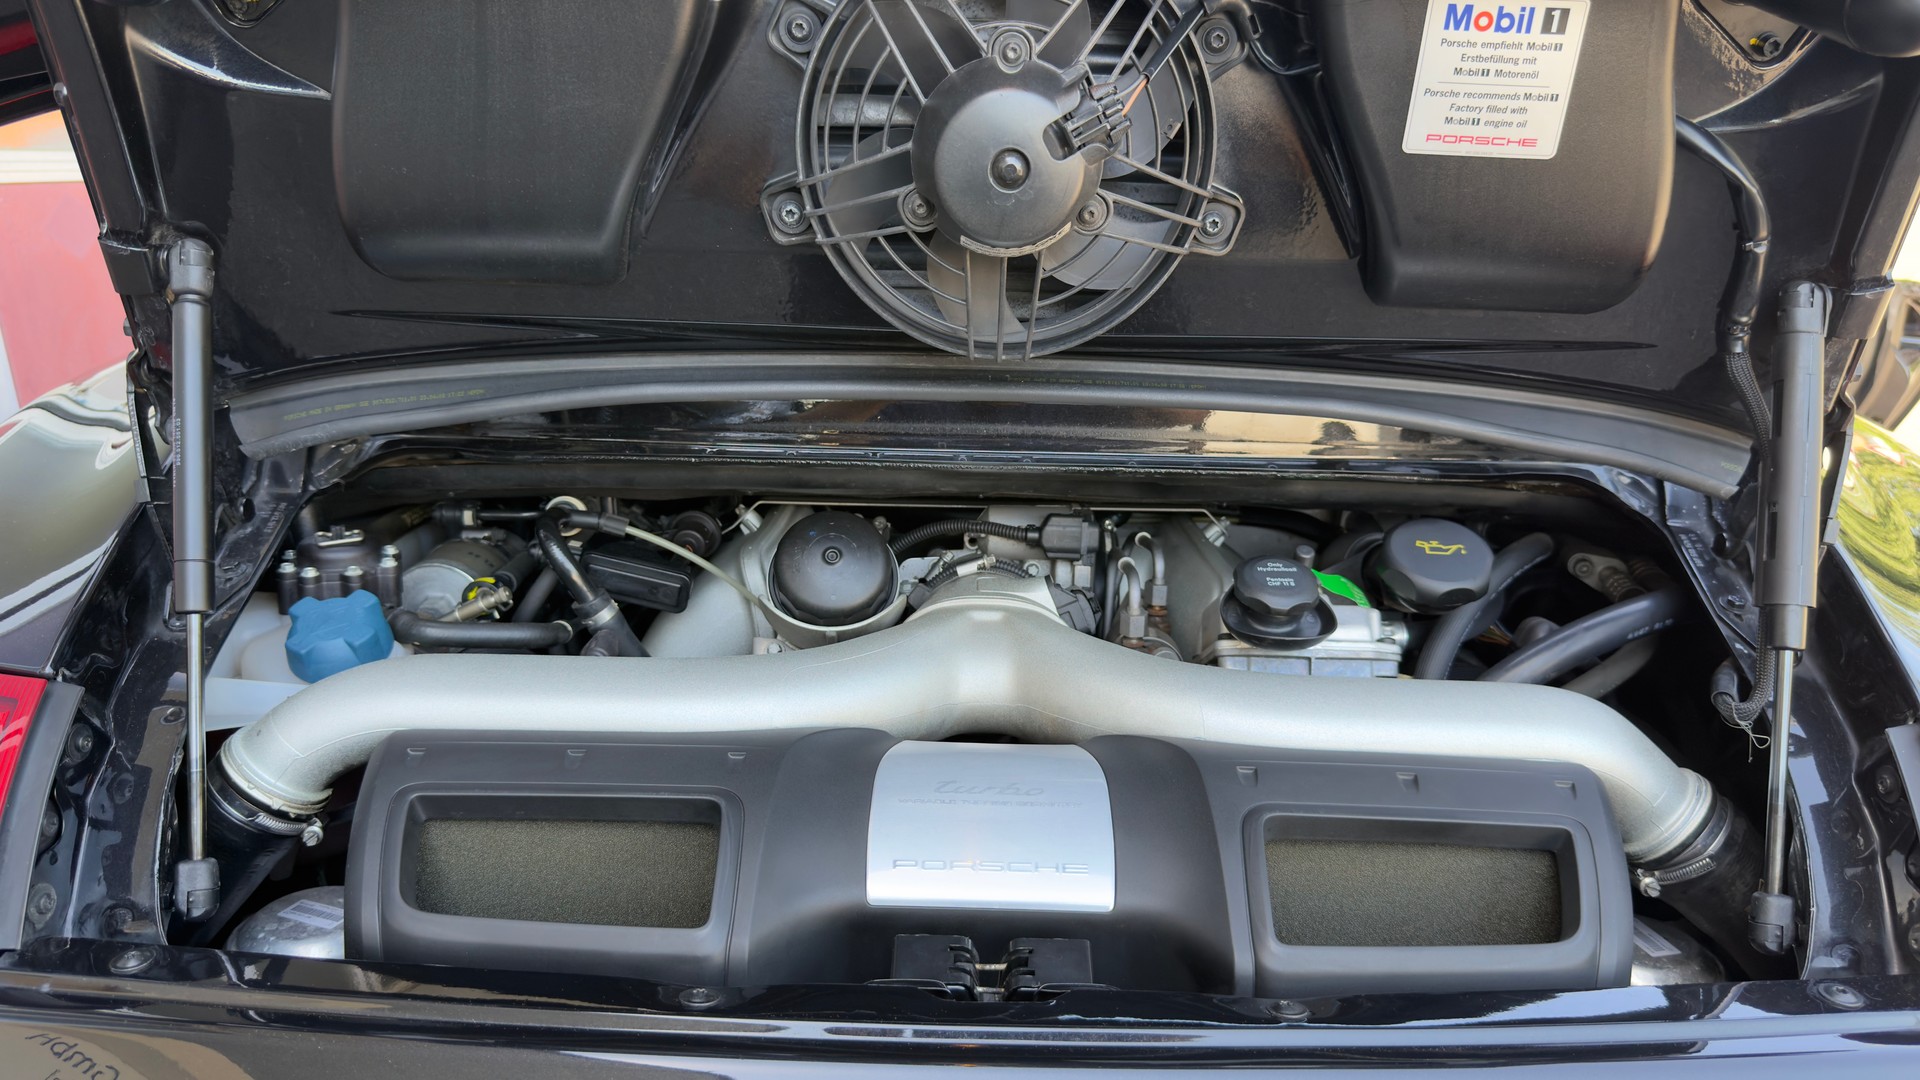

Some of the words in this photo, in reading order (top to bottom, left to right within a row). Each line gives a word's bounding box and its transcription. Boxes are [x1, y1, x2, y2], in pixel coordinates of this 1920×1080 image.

[1443, 4, 1536, 34] Mobil
[1440, 38, 1478, 49] Porsche
[1480, 40, 1524, 51] empfiehlt
[1526, 42, 1552, 52] Mobil
[1460, 54, 1520, 66] Erstbefüllung
[1522, 57, 1537, 66] mit
[1453, 67, 1480, 77] Mobil
[1493, 69, 1540, 80] Motorenöl
[1423, 88, 1461, 98] Porsche
[1462, 89, 1522, 101] recommends
[1523, 92, 1550, 102] Mobil
[1449, 103, 1484, 115] Factory
[1486, 105, 1508, 115] filled
[1510, 106, 1528, 116] with
[1444, 116, 1471, 126] Mobil
[1483, 119, 1515, 130] engine
[1516, 120, 1528, 129] oil
[1425, 133, 1539, 148] PORSCHE
[933, 779, 1045, 797] turbo
[892, 858, 1089, 876] PORSCHE
